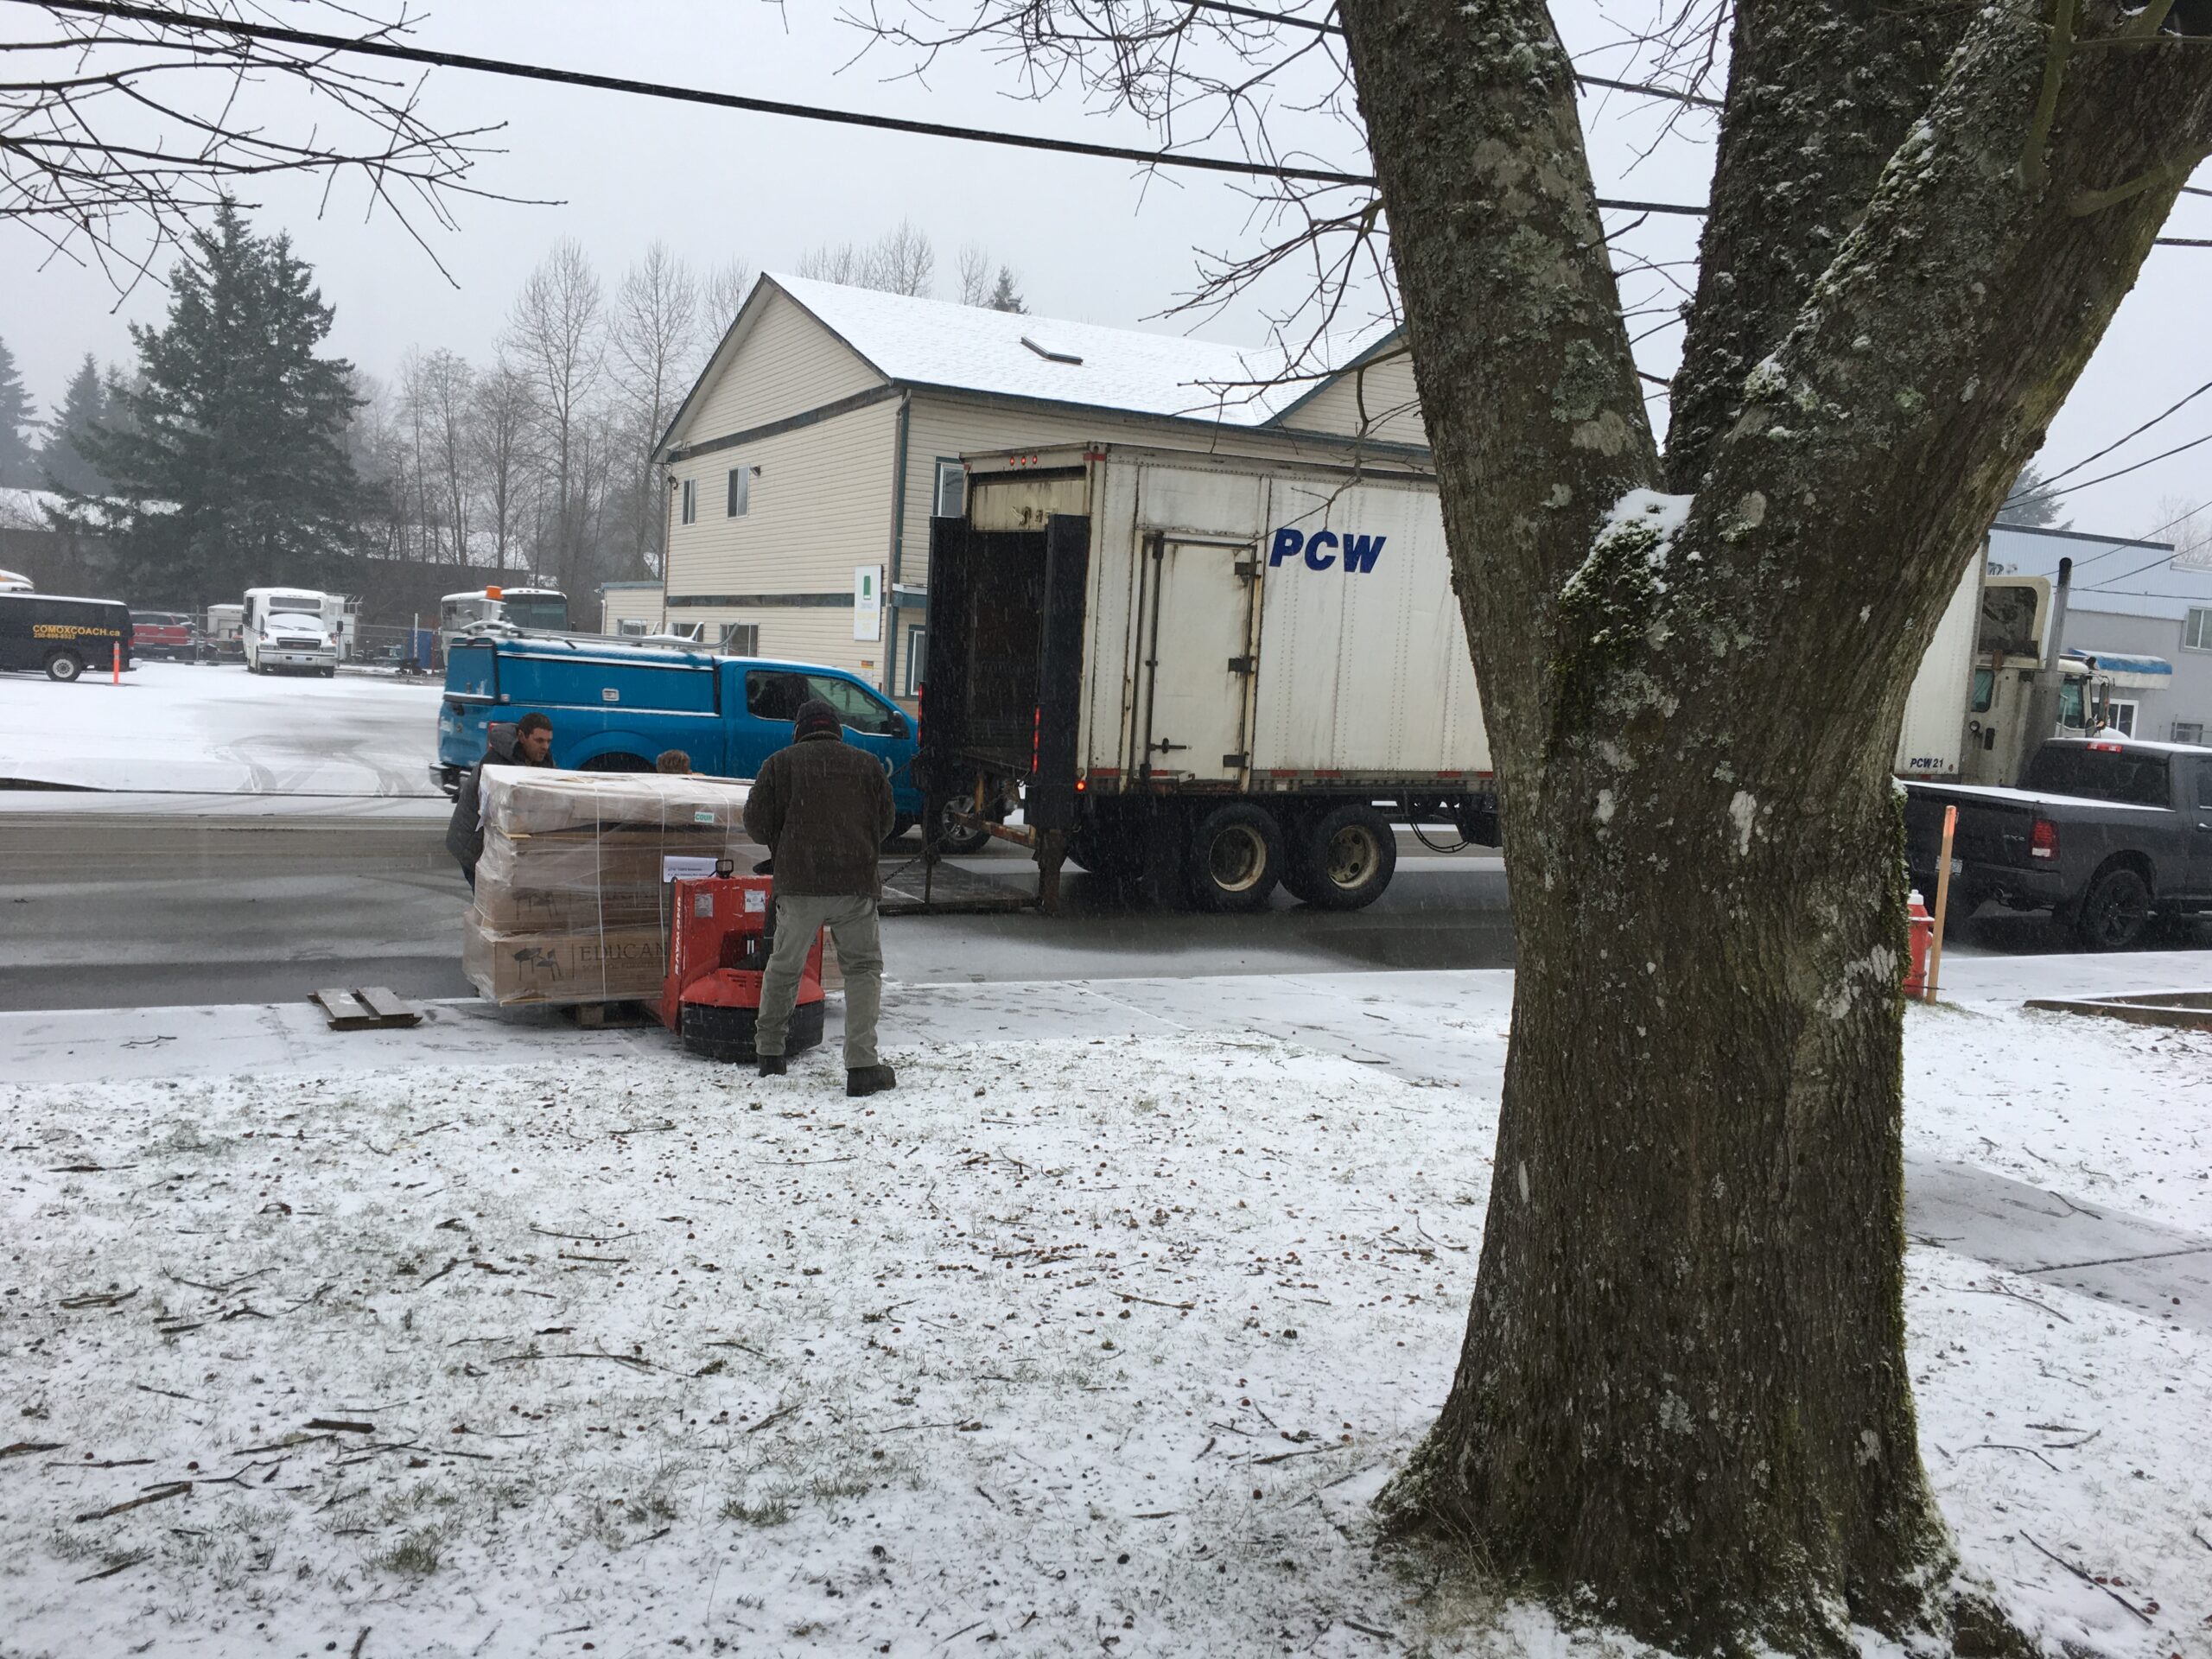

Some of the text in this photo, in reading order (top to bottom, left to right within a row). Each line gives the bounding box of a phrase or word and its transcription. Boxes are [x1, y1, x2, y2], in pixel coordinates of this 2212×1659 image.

[1268, 528, 1387, 574] PCW
[33, 625, 120, 637] COMOXCOACH.ca
[1910, 758, 1944, 768] PCW 21
